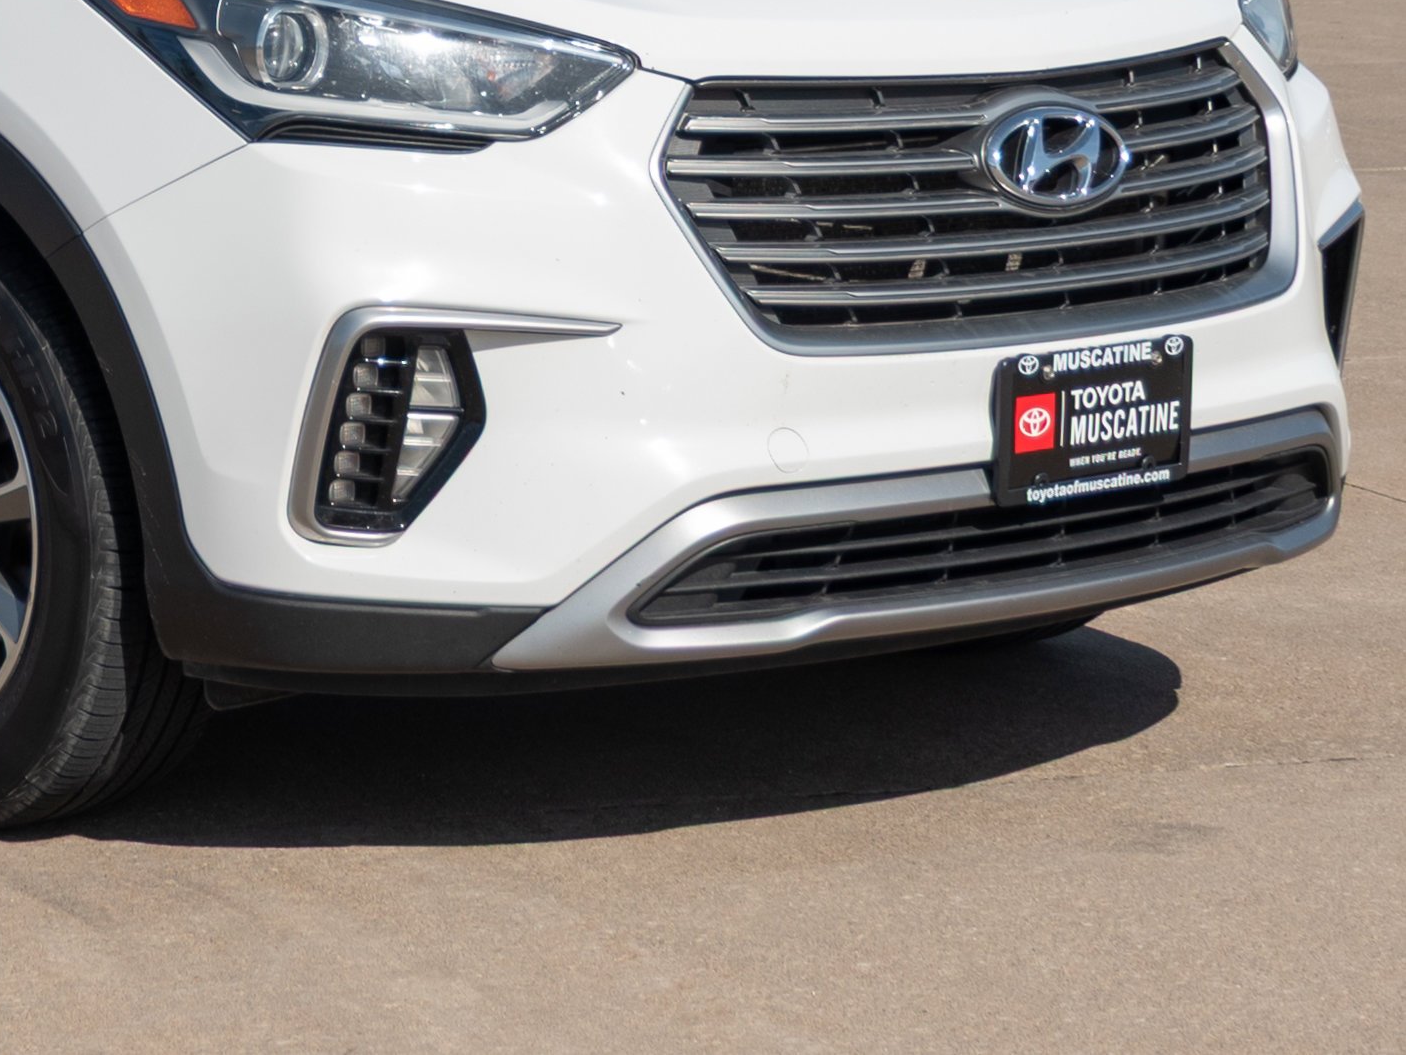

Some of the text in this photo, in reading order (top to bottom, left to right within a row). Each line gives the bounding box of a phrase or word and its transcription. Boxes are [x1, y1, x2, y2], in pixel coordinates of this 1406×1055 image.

[1053, 342, 1152, 372] MUSCATINE
[1070, 380, 1146, 410] TOYOTA
[1069, 400, 1181, 446] MUSCATINE
[1027, 468, 1170, 503] toyotaofmuscatine.com
